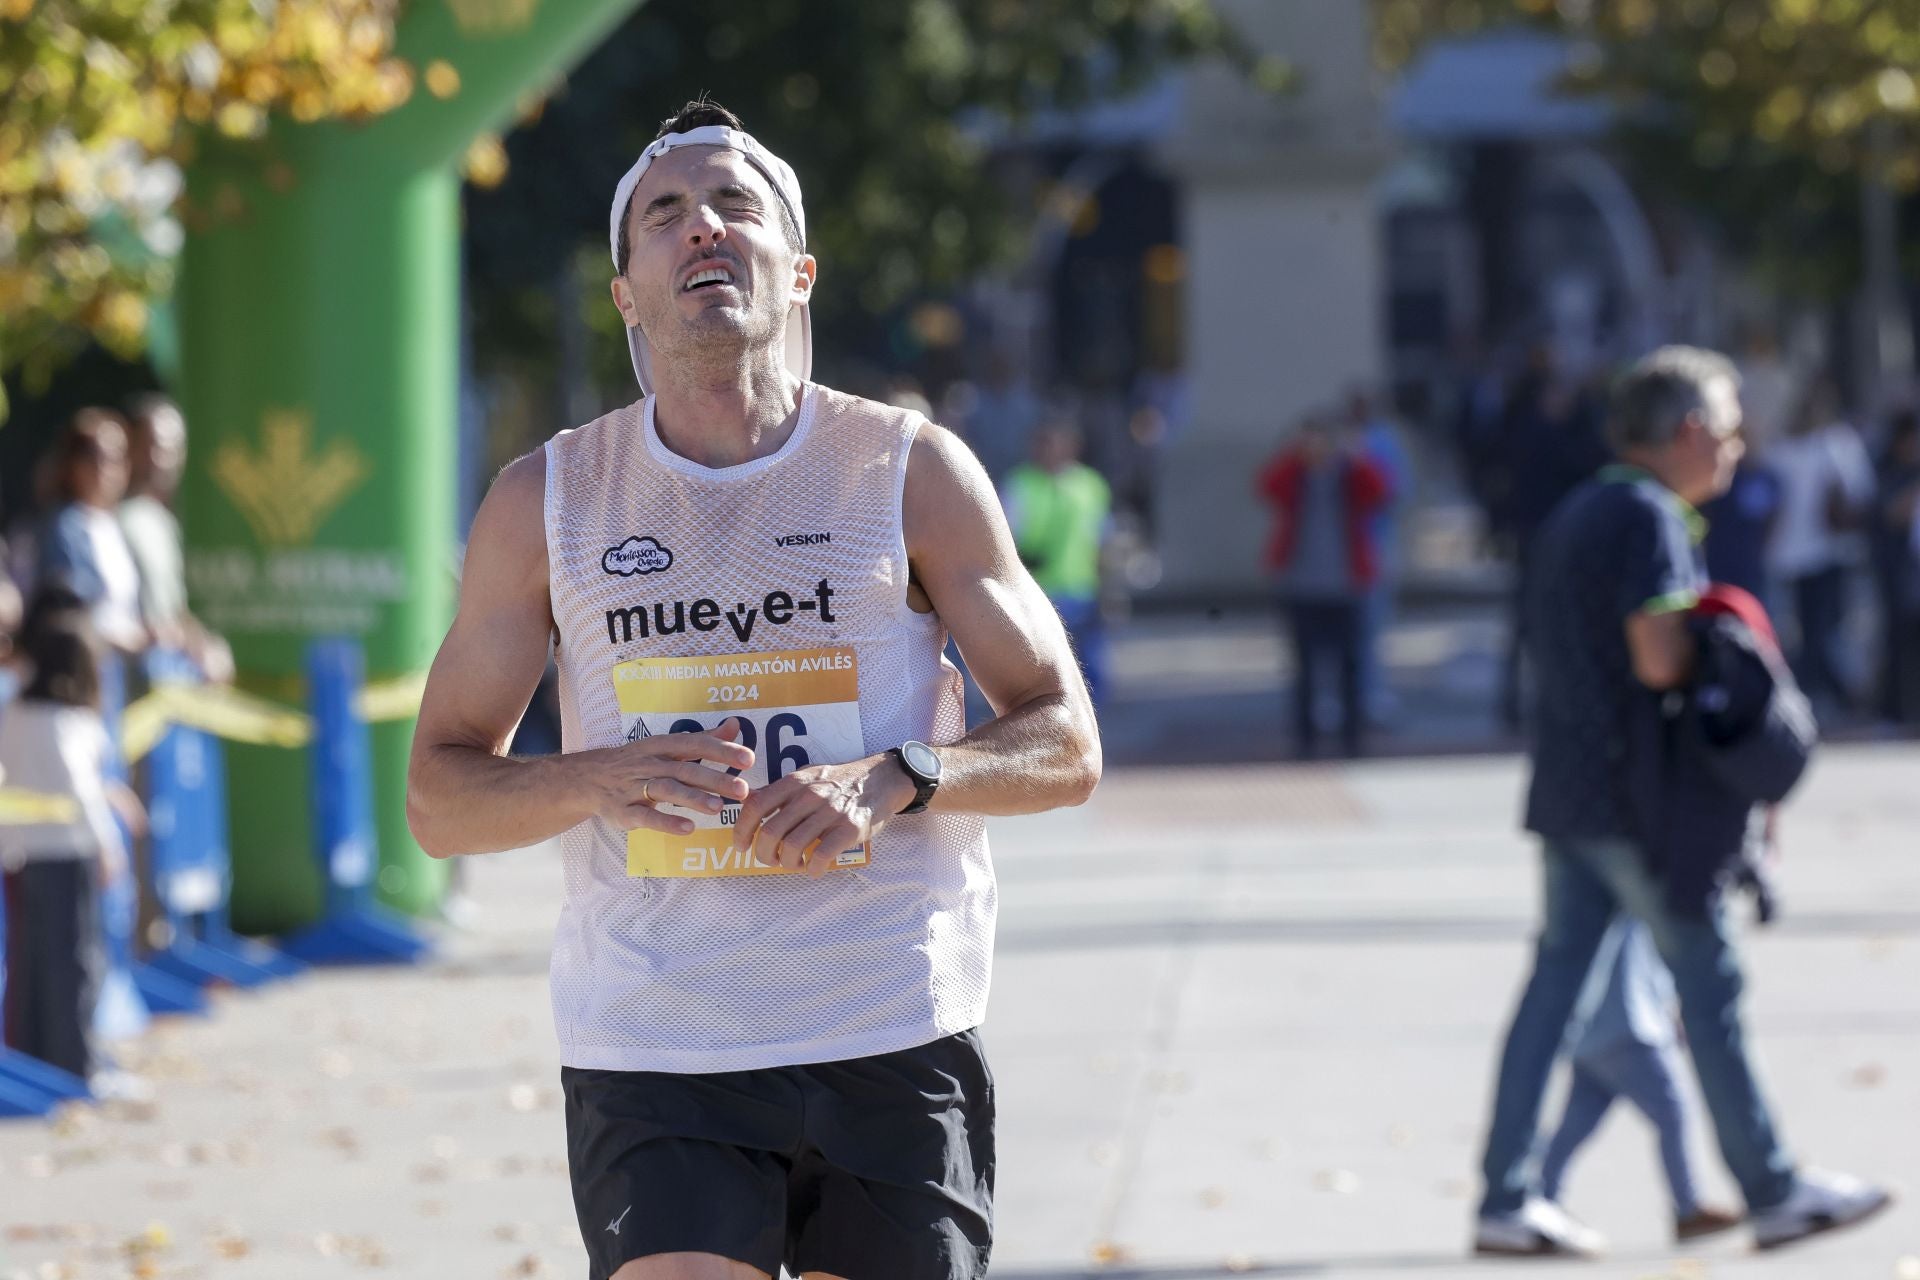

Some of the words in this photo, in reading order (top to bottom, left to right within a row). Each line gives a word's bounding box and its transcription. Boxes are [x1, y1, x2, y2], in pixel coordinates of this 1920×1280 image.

[775, 532, 831, 548] VESKIN
[665, 664, 711, 680] MEDIA
[714, 656, 797, 678] MARATÓN
[800, 652, 853, 672] AVILÉS
[707, 684, 759, 703] 2024
[669, 712, 810, 806] 26
